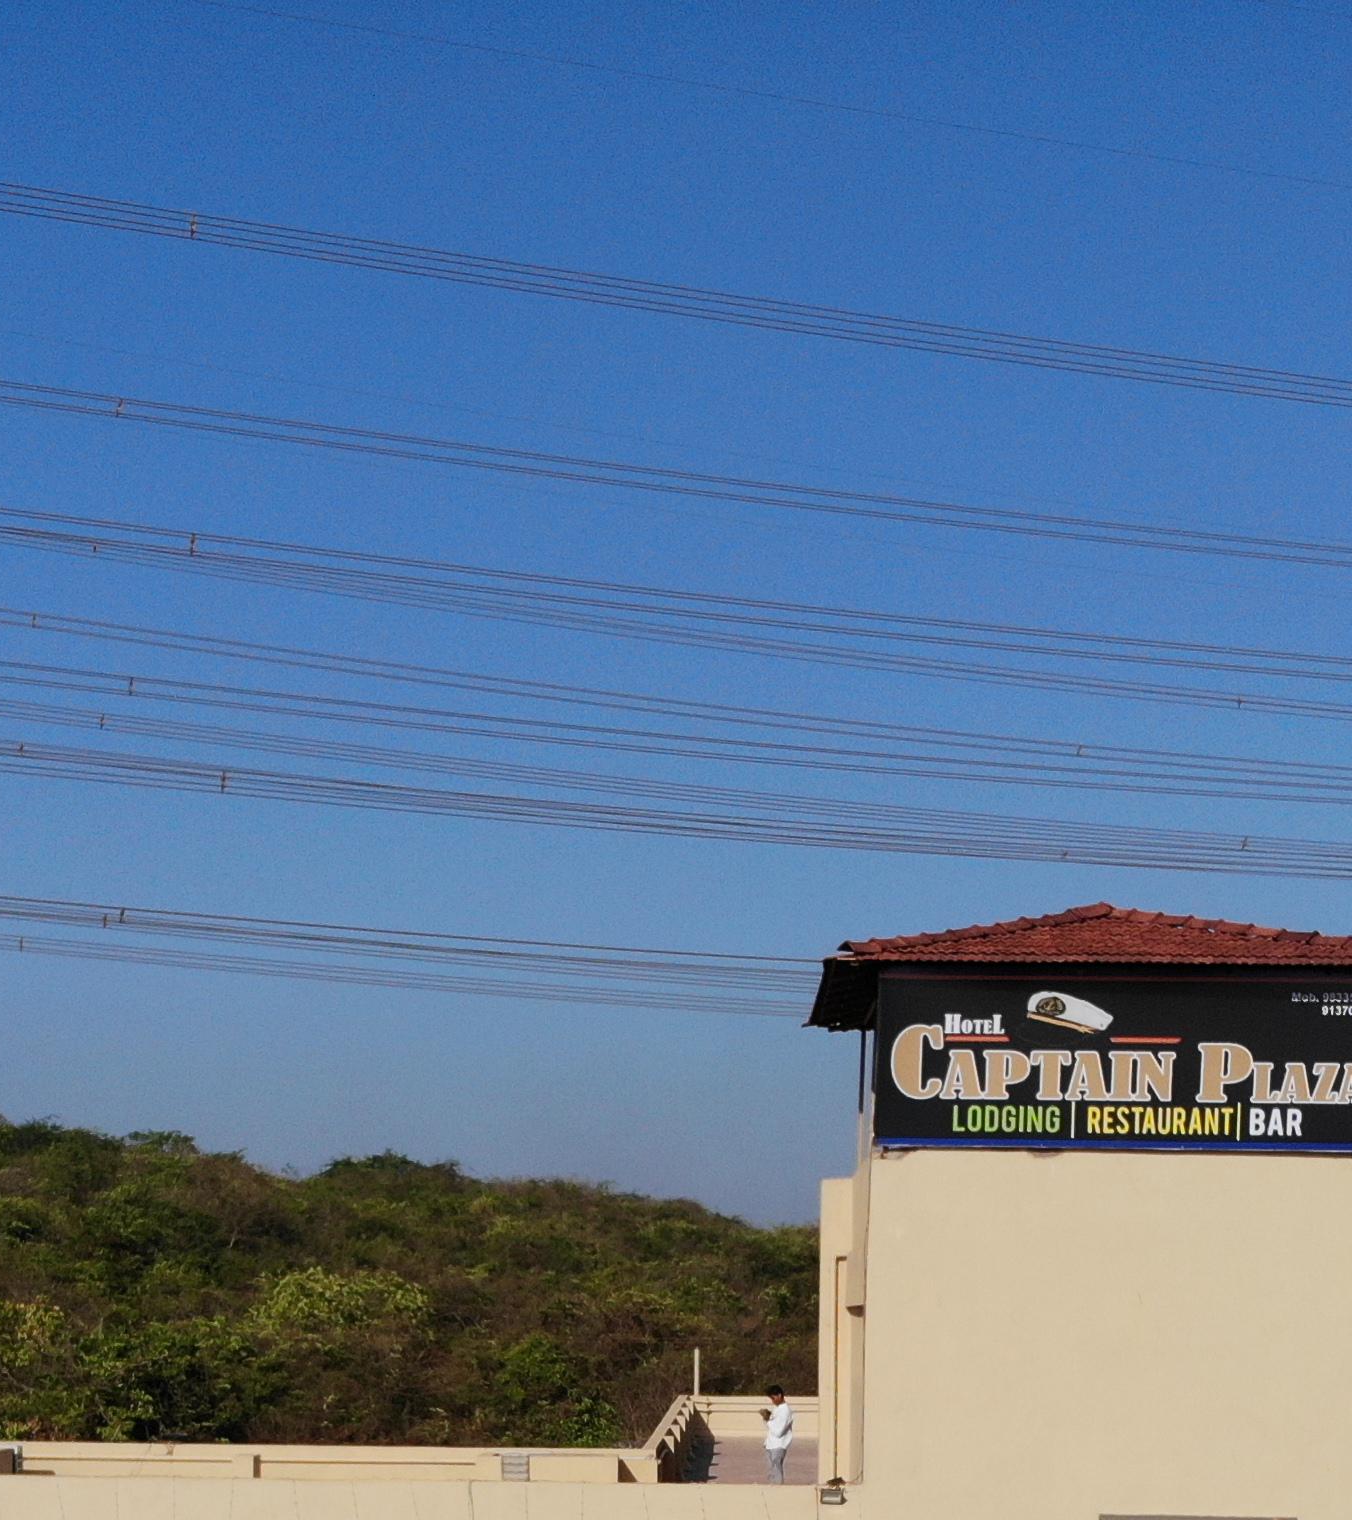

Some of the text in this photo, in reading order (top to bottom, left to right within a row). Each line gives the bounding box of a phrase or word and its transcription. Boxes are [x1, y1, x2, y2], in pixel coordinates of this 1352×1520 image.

[944, 1013, 1005, 1035] HOTEL
[890, 1024, 1176, 1102] CAPTAIN
[952, 1104, 1302, 1136] LODGING RESTAURANT BAR
